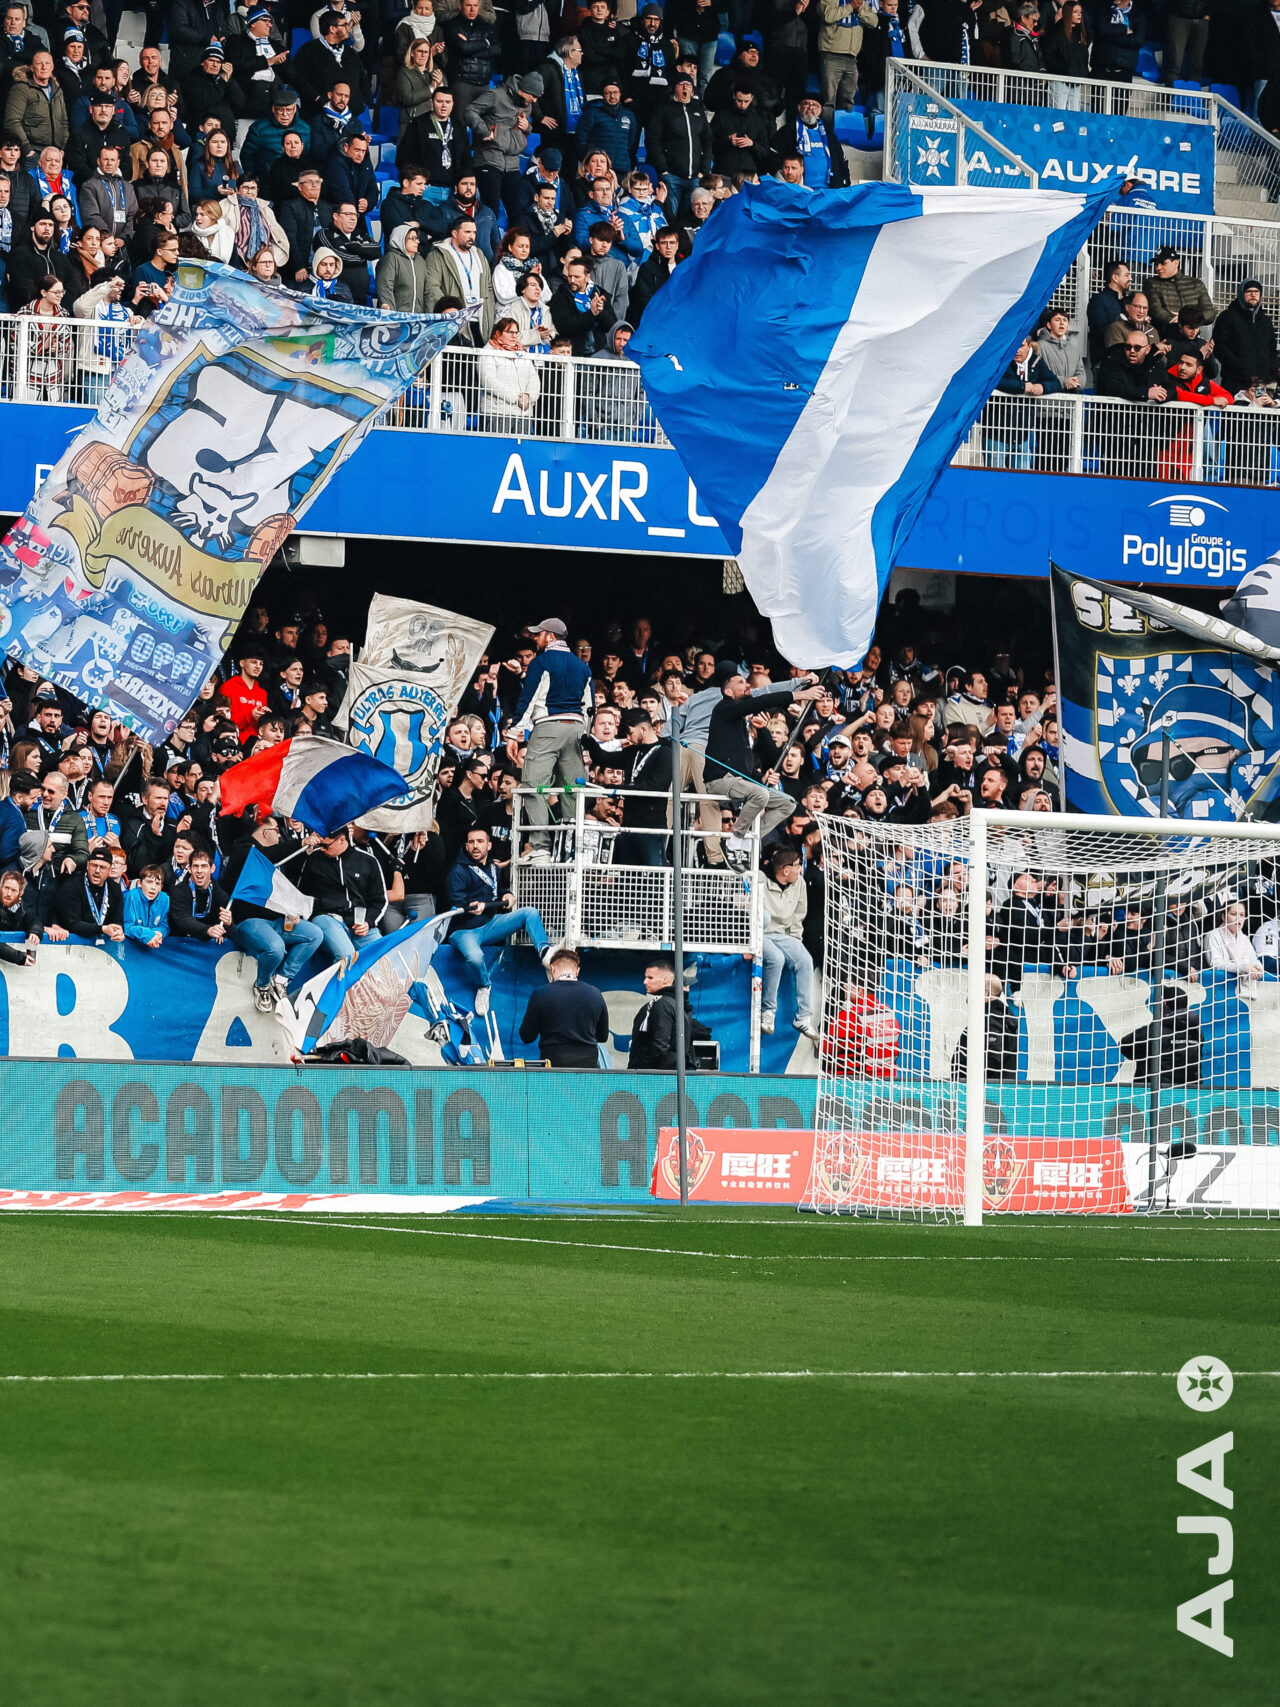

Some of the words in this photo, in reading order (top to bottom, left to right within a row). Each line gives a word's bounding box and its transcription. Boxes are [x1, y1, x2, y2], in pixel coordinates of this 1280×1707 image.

[1041, 154, 1201, 194] AUXRRE
[1122, 533, 1248, 578] Polylogis
[1191, 533, 1224, 546] Groupe
[352, 684, 394, 721] ULTRAS
[399, 685, 447, 723] AUXERRE
[55, 1080, 491, 1186] ACADOMIA
[721, 1152, 791, 1178] 犀旺
[1033, 1161, 1104, 1187] 犀旺
